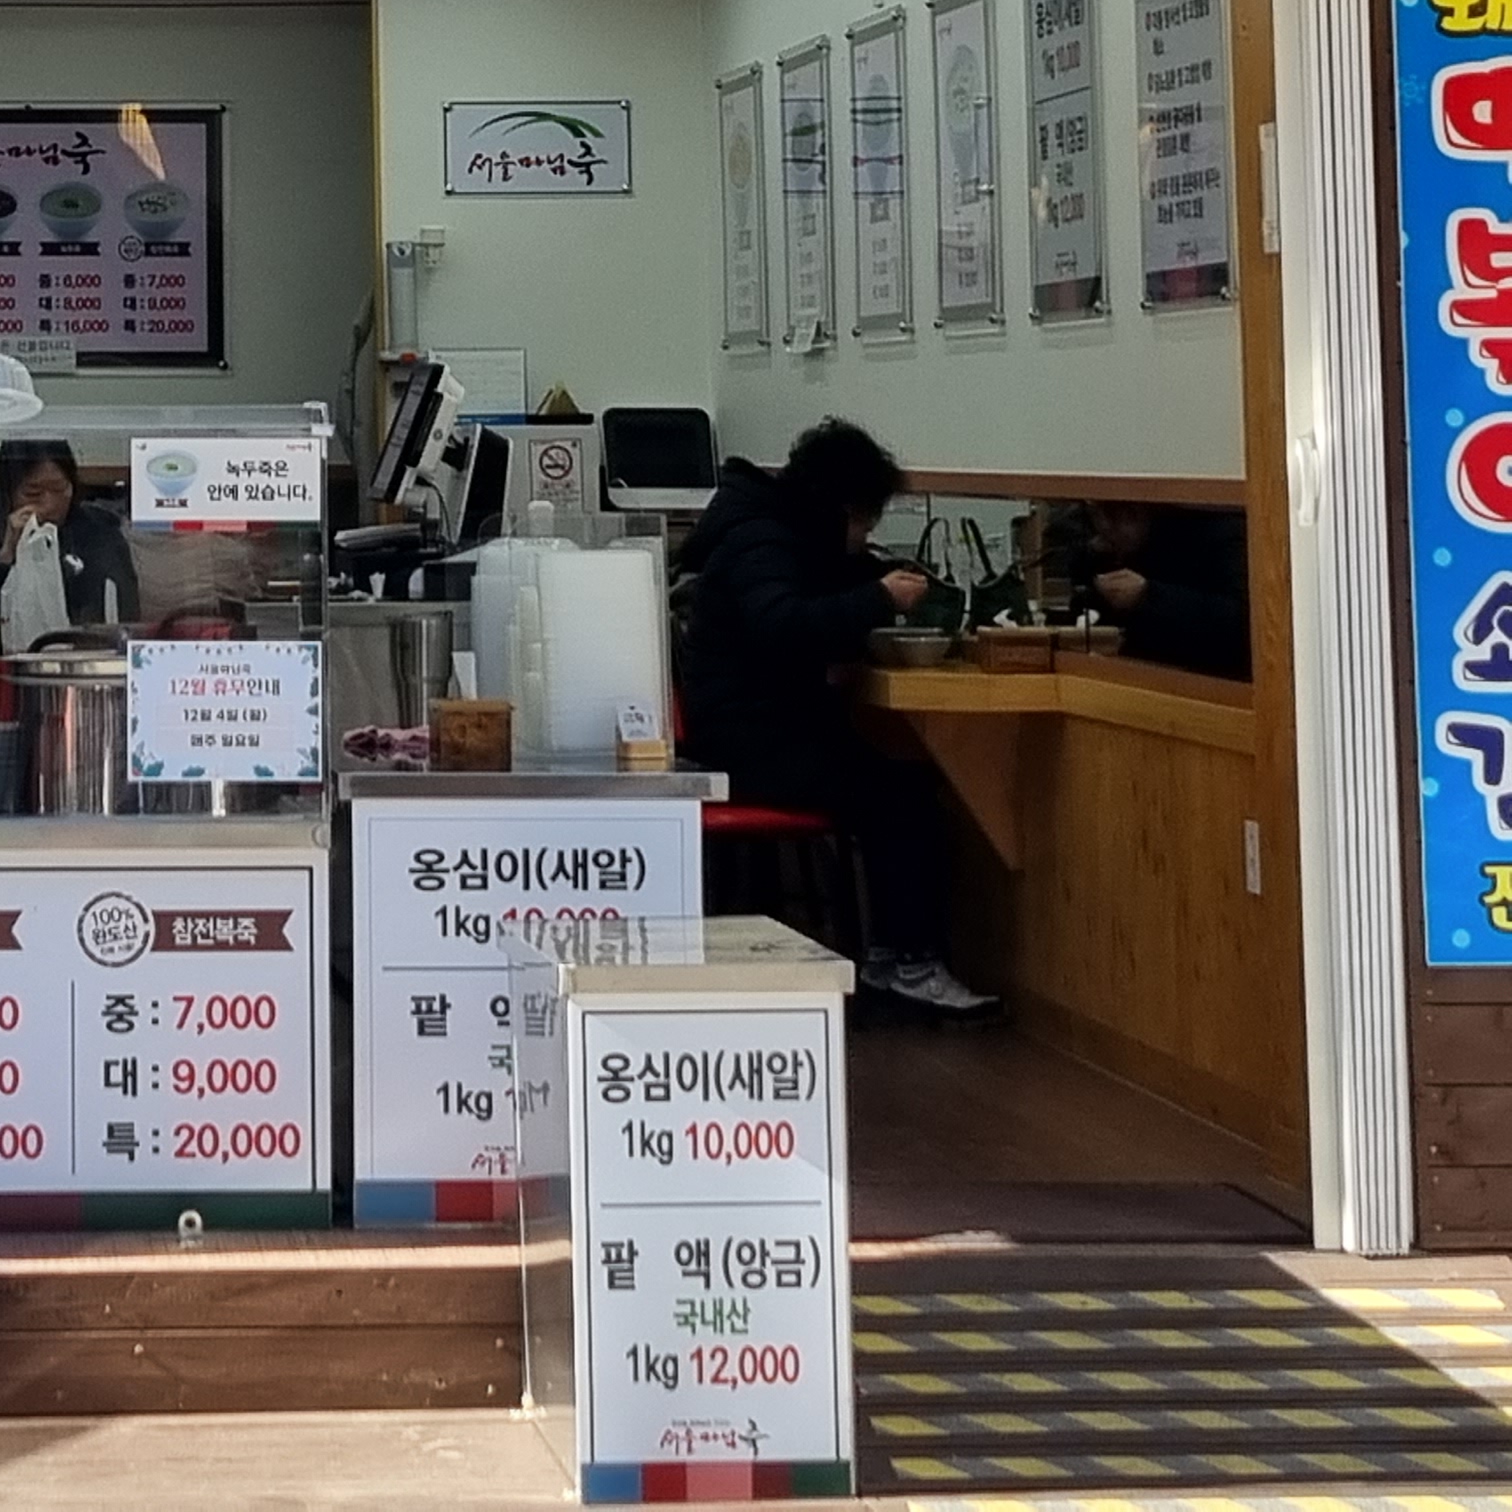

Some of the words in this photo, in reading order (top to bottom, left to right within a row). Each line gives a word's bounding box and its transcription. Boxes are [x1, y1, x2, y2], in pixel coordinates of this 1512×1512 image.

[226, 460, 289, 478] 녹두죽은
[207, 484, 238, 501] 안에
[245, 484, 313, 502] 있습니다.
[170, 678, 207, 696] 12월
[214, 678, 281, 696] 휴무안내
[183, 709, 212, 722] 12월
[408, 846, 647, 892] 옹심이(새알)
[91, 906, 135, 926] 100%
[171, 916, 257, 945] 참전복죽
[434, 905, 490, 943] 1kg
[91, 925, 138, 946] 완도산
[172, 995, 276, 1035] 7,000
[410, 994, 452, 1037] 팥
[171, 1059, 276, 1100] 9,000
[597, 1049, 816, 1105] 옹심이(새알)
[436, 1082, 493, 1120] 1kg
[172, 1123, 301, 1164] 20,000
[621, 1119, 674, 1165] 1kg
[685, 1120, 795, 1166] 10,000
[673, 1297, 750, 1336] 국내산
[627, 1343, 680, 1389] 1kg
[690, 1344, 800, 1390] 12,000
